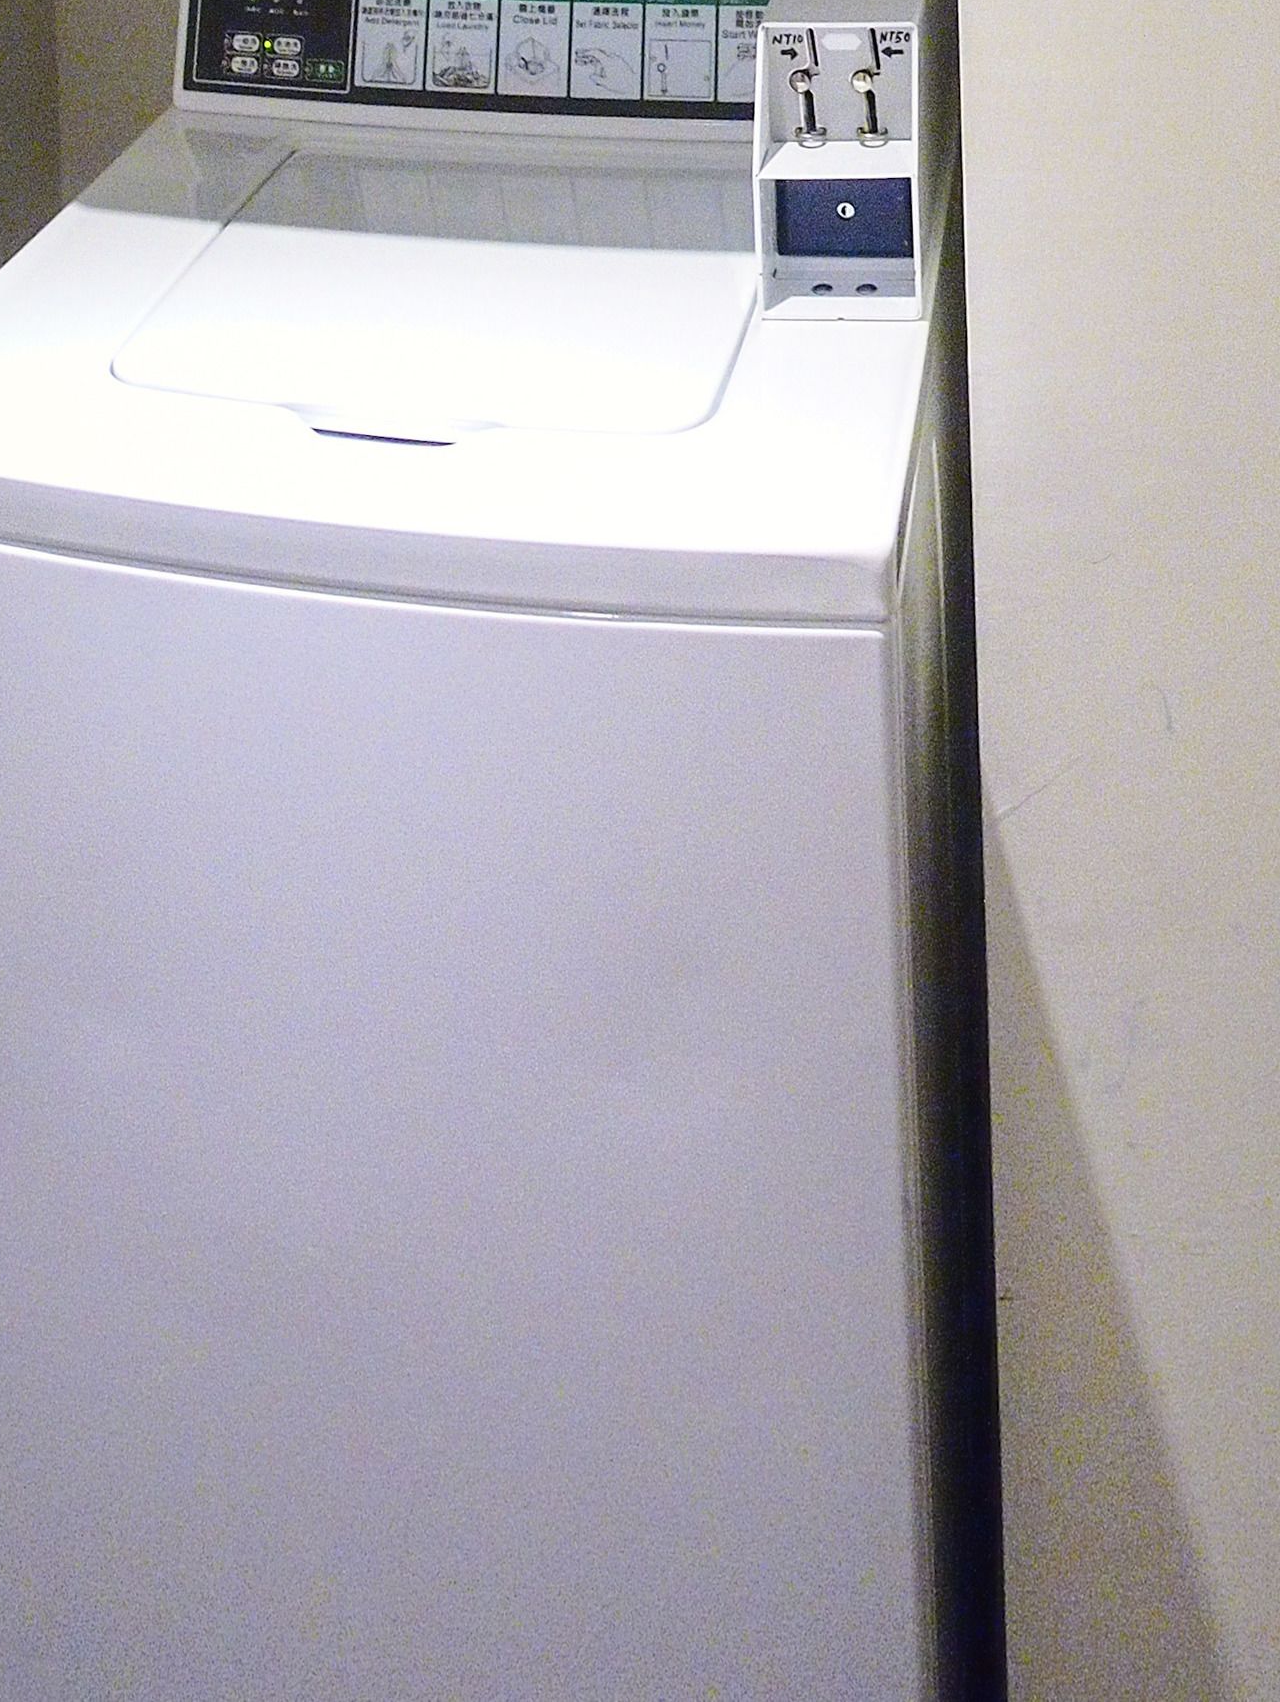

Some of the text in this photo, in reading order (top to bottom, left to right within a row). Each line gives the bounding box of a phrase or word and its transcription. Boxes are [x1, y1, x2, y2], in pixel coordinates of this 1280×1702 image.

[513, 14, 558, 26] Close Lid
[772, 31, 911, 44] NT10 NT50
